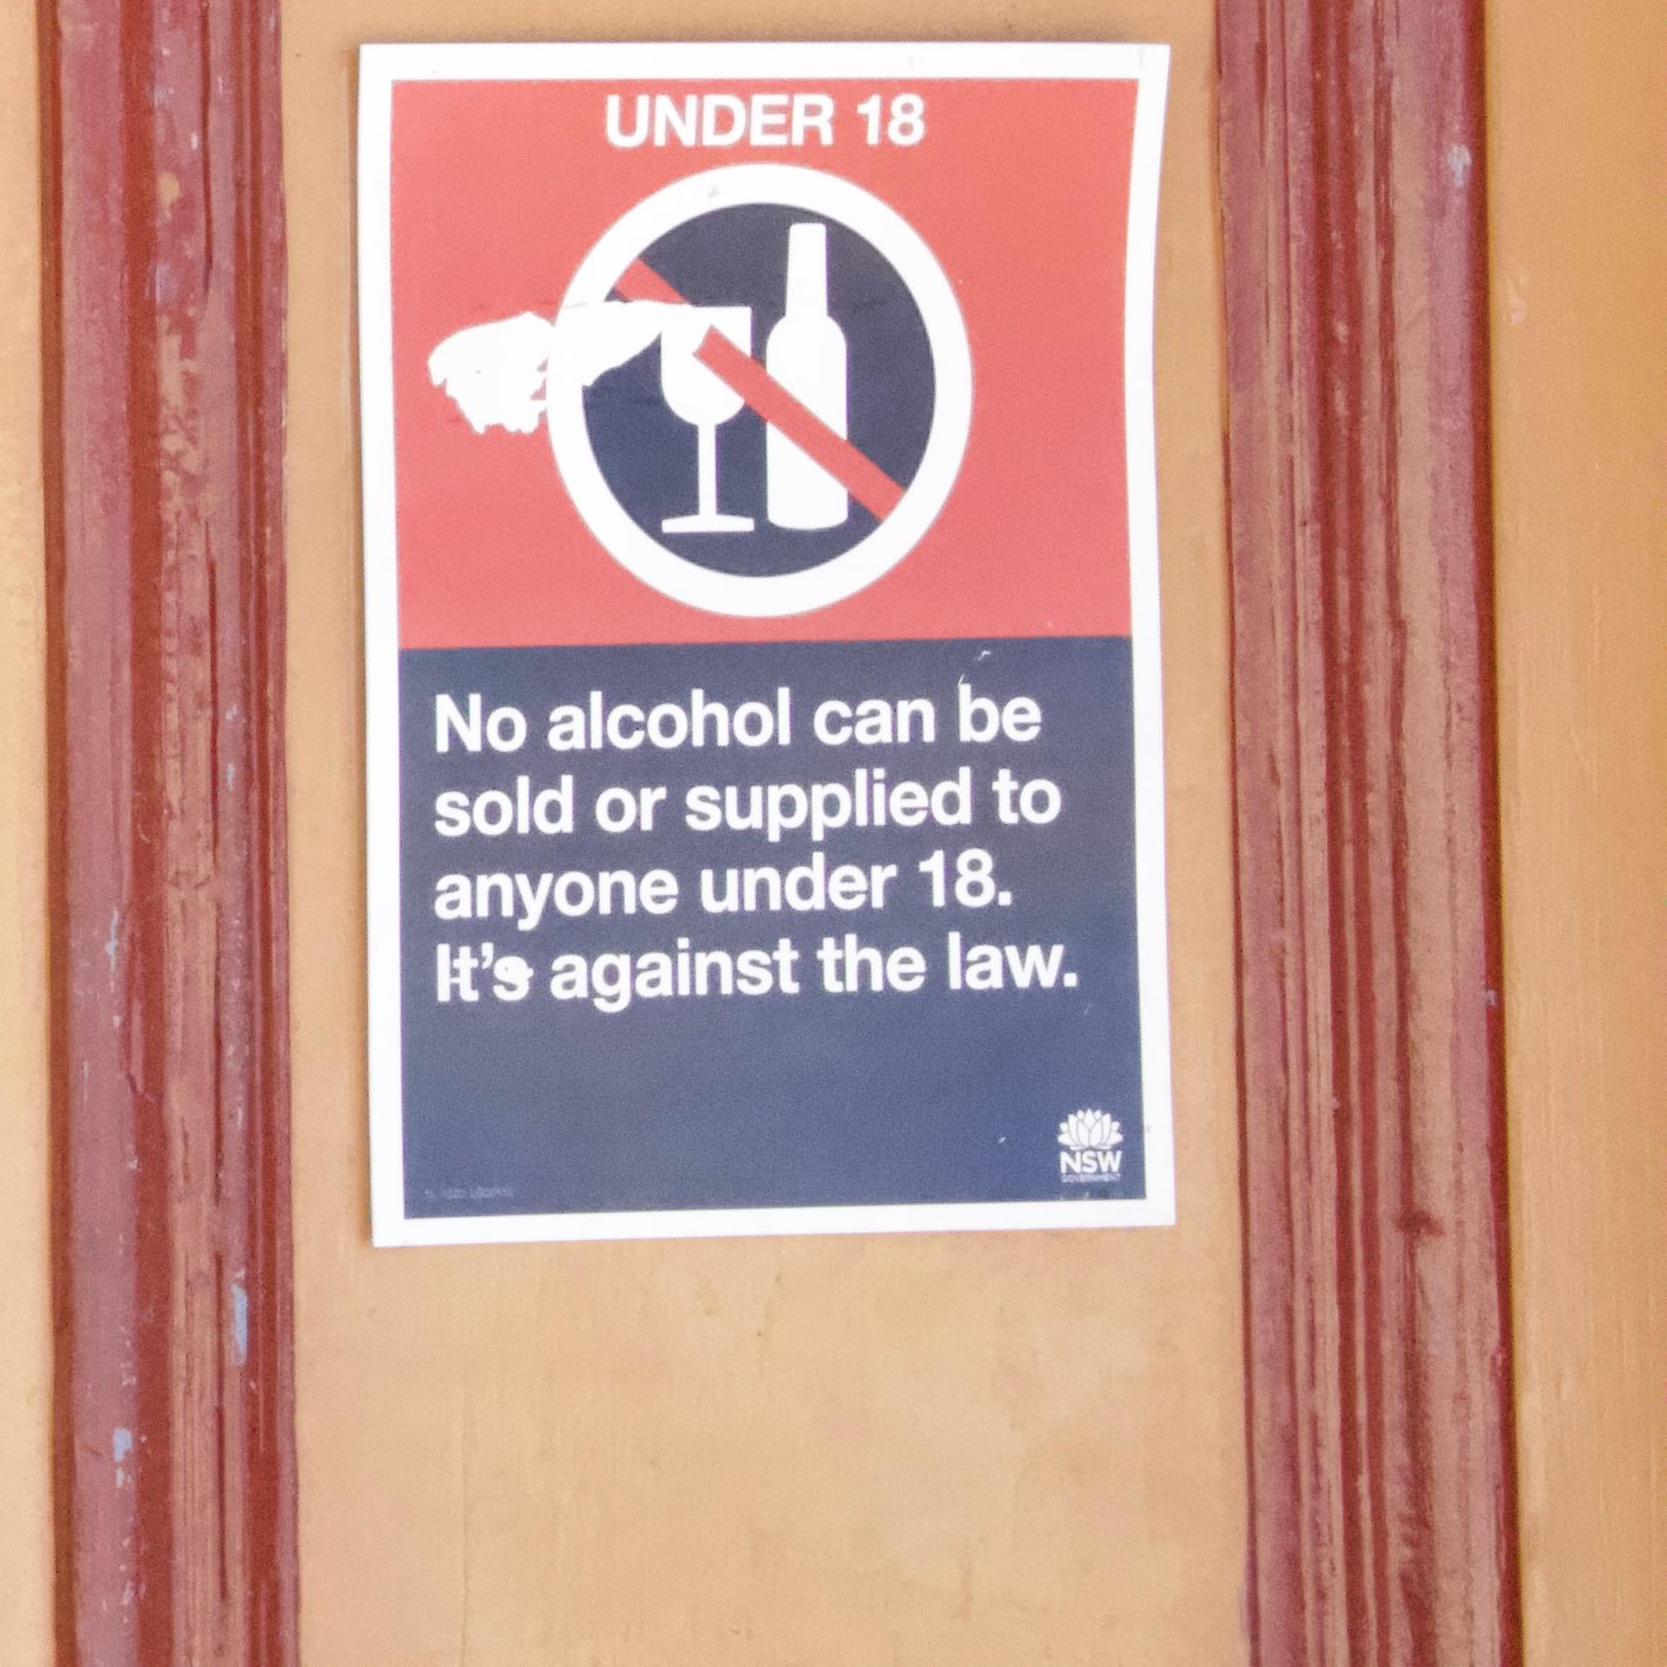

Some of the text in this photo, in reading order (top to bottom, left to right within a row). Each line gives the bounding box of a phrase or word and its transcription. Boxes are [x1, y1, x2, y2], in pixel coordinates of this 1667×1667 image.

[607, 93, 925, 147] UNDER 18
[436, 684, 1043, 752] No alcohol can be
[435, 766, 1061, 842] sold or supplied to
[434, 848, 1011, 931] anyone under 18.
[550, 938, 799, 1013] against
[817, 934, 926, 992] the
[948, 932, 1077, 990] law.
[1061, 1150, 1121, 1174] NSW
